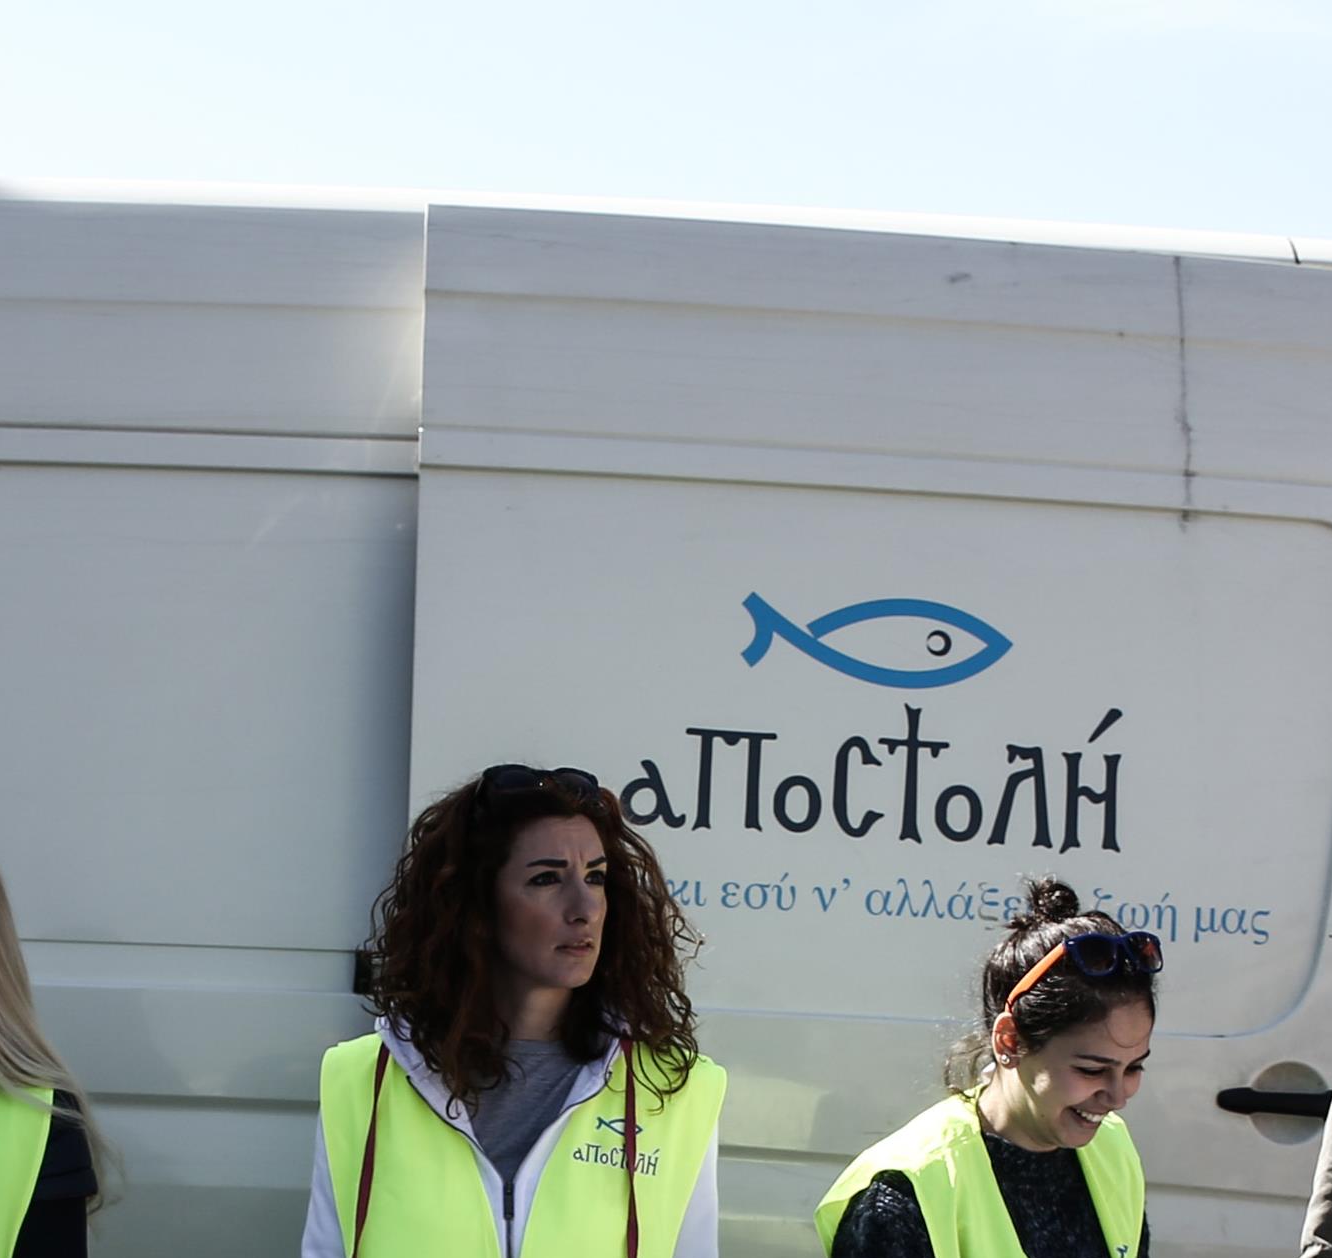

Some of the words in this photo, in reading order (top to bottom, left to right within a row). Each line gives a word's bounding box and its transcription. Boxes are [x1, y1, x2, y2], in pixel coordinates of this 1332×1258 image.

[720, 872, 796, 911] εσύ
[865, 878, 1029, 930] αλλάξε
[1194, 906, 1271, 945] μας
